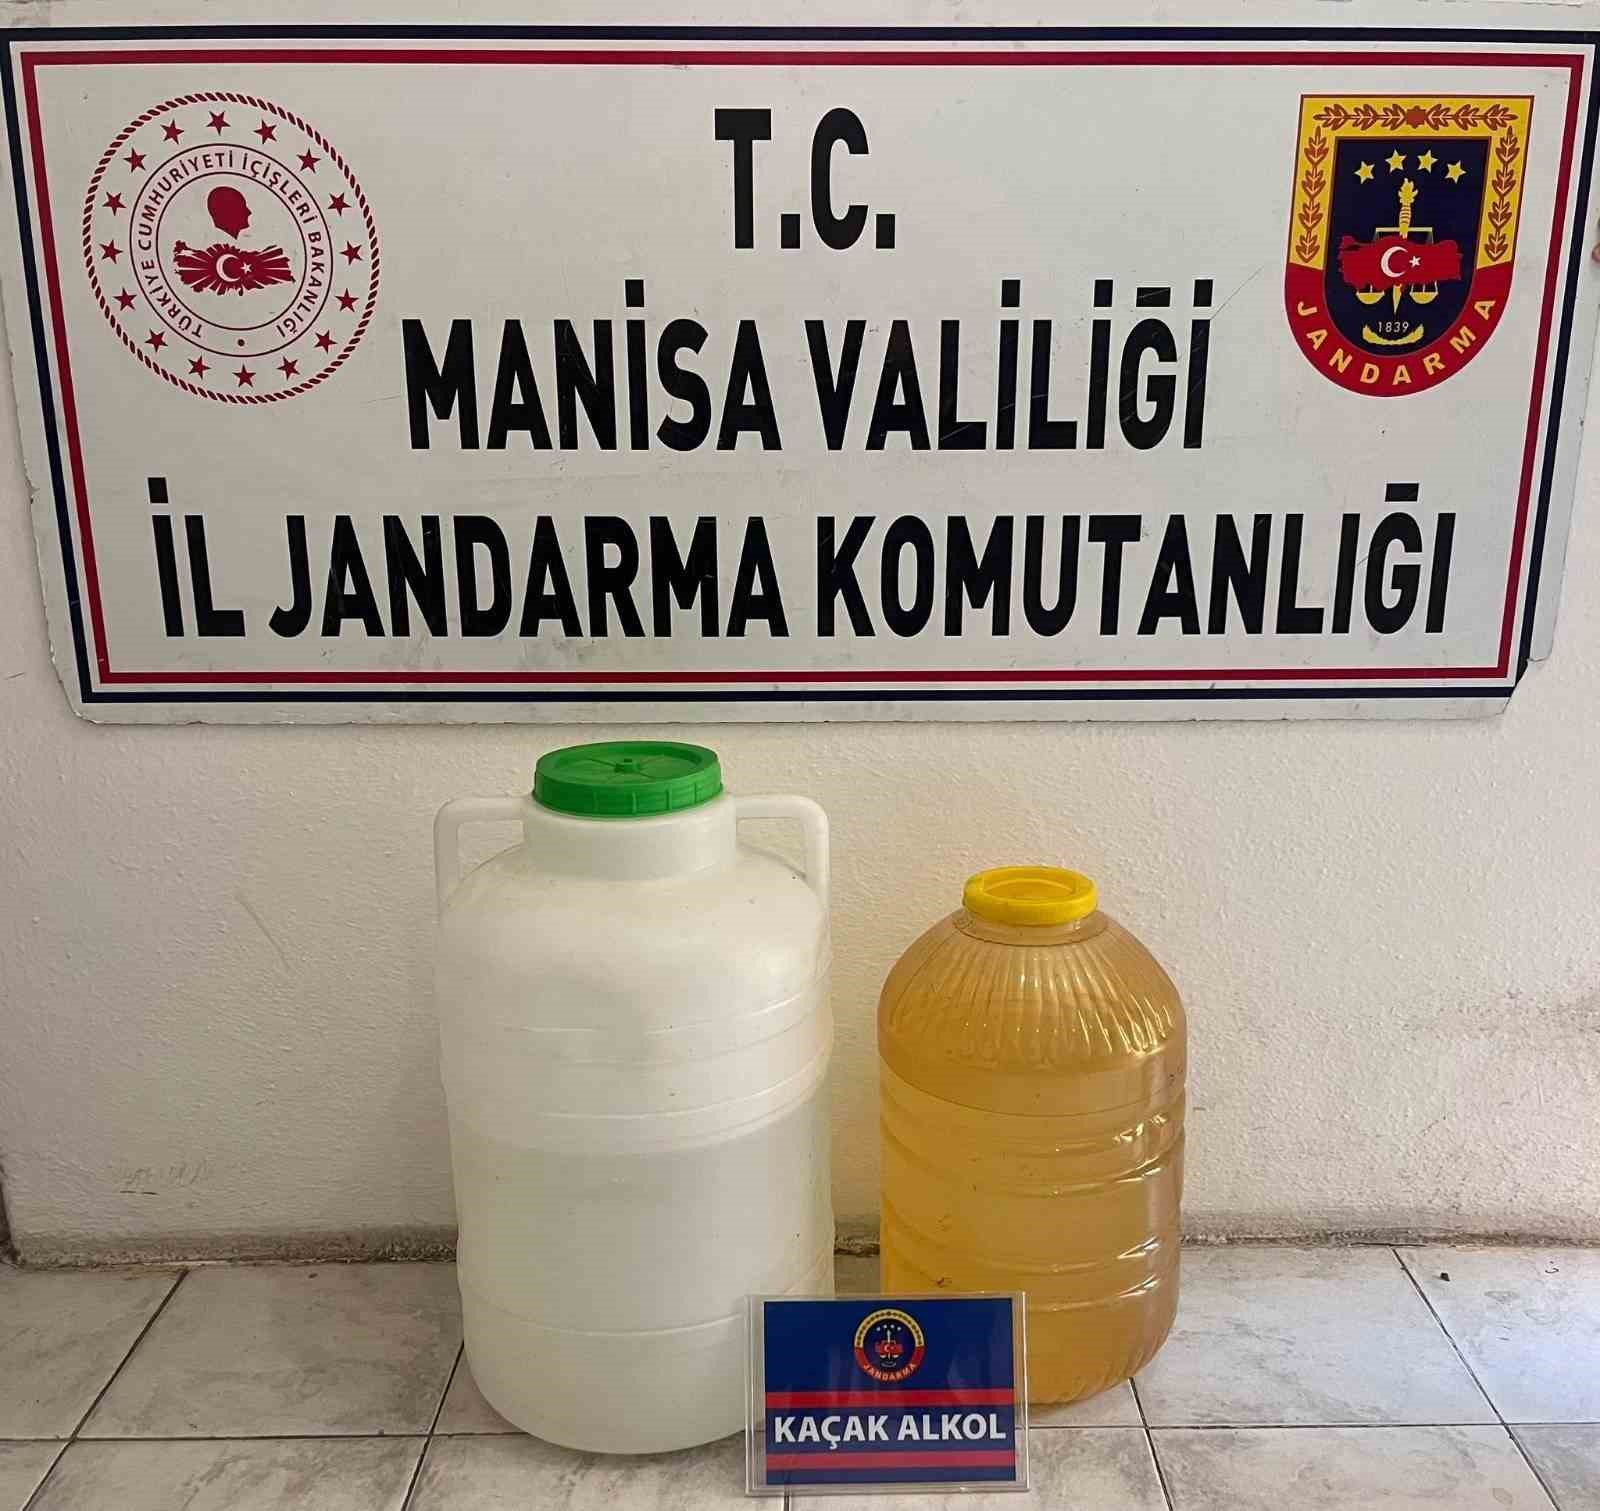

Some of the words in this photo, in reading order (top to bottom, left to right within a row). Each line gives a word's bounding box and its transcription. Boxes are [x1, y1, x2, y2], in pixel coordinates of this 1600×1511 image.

[137, 149, 234, 251] CUMHURİYETİ
[241, 152, 317, 225] İÇİŞLERİ
[714, 108, 897, 249] T.C.
[141, 261, 203, 338] TÜRKİYE
[275, 230, 325, 339] BAKANLIĞI
[1377, 320, 1410, 334] 1839
[401, 279, 783, 452] MANİSA
[804, 279, 1214, 451] VALİLİĞİ
[1296, 298, 1496, 386] JANDARMA
[147, 476, 246, 638] İL
[268, 514, 790, 638] JANDARMA
[817, 483, 1457, 638] KOMUTANLIĞI
[863, 1363, 917, 1382] JANDARMA
[774, 1415, 890, 1450] KAÇAK
[897, 1412, 1007, 1441] ALKOL
